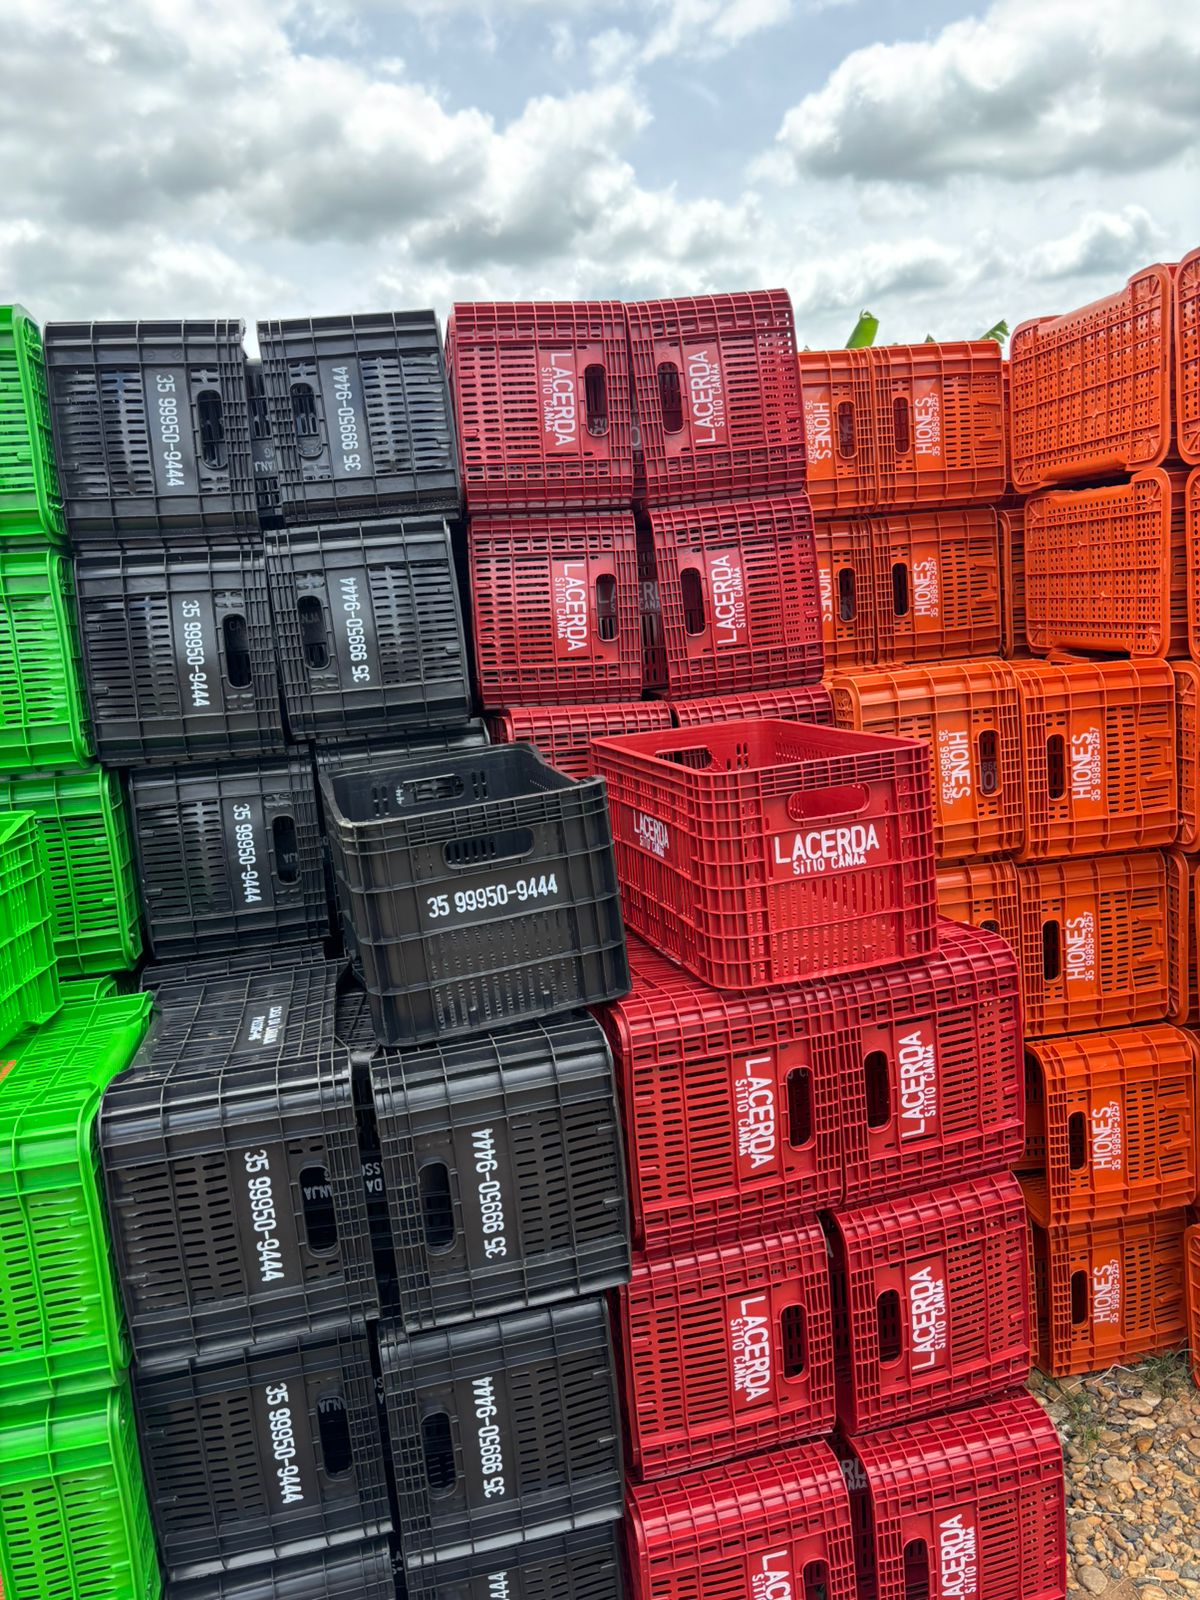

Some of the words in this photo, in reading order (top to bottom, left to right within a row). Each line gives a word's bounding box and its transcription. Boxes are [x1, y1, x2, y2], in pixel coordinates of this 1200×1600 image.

[156, 374, 174, 393] 35
[332, 367, 360, 453] 99950-9444
[551, 353, 576, 446] LACERDA
[688, 350, 716, 443] LACERDA
[157, 397, 185, 487] 99950-9444
[814, 402, 832, 460] HIONES
[915, 396, 933, 455] HIONES
[932, 445, 940, 456] 35
[344, 455, 361, 472] 35
[183, 599, 201, 617] 35
[339, 577, 369, 661] 99950-9444
[564, 563, 587, 651] LACERDA
[711, 555, 737, 644] LACERDA
[913, 562, 930, 617] HIONES
[930, 607, 939, 618] 35
[182, 621, 210, 708] 99950-9444
[352, 665, 370, 682] 35
[938, 729, 948, 742] 35
[948, 731, 971, 799] HIONES
[1072, 733, 1092, 799] HIONES
[232, 803, 251, 821] 35
[1091, 789, 1101, 802] 35
[633, 809, 670, 849] LACERDA
[774, 823, 880, 864] LACERDA
[235, 824, 262, 903] 99950-9444
[427, 894, 450, 919] 35
[455, 873, 559, 914] 99950-9444
[1066, 917, 1086, 980] HIONES
[1085, 970, 1095, 981] 35
[745, 1056, 775, 1169] LACERDA
[899, 1031, 925, 1137] LACERDA
[245, 1150, 269, 1171] 35
[1092, 1107, 1112, 1170] HIONES
[1111, 1159, 1121, 1171] 35
[471, 1128, 504, 1232] 99950-9444
[247, 1177, 284, 1282] 99950-9444
[485, 1236, 507, 1259] 35
[909, 1266, 935, 1371] LACERDA
[1093, 1265, 1112, 1323] HIONES
[740, 1295, 771, 1401] LACERDA
[266, 1383, 288, 1403] 35
[270, 1407, 303, 1504] 99950-9444
[472, 1376, 503, 1475] 99950-9444
[484, 1478, 504, 1498] 35
[939, 1513, 965, 1600] ACERDA
